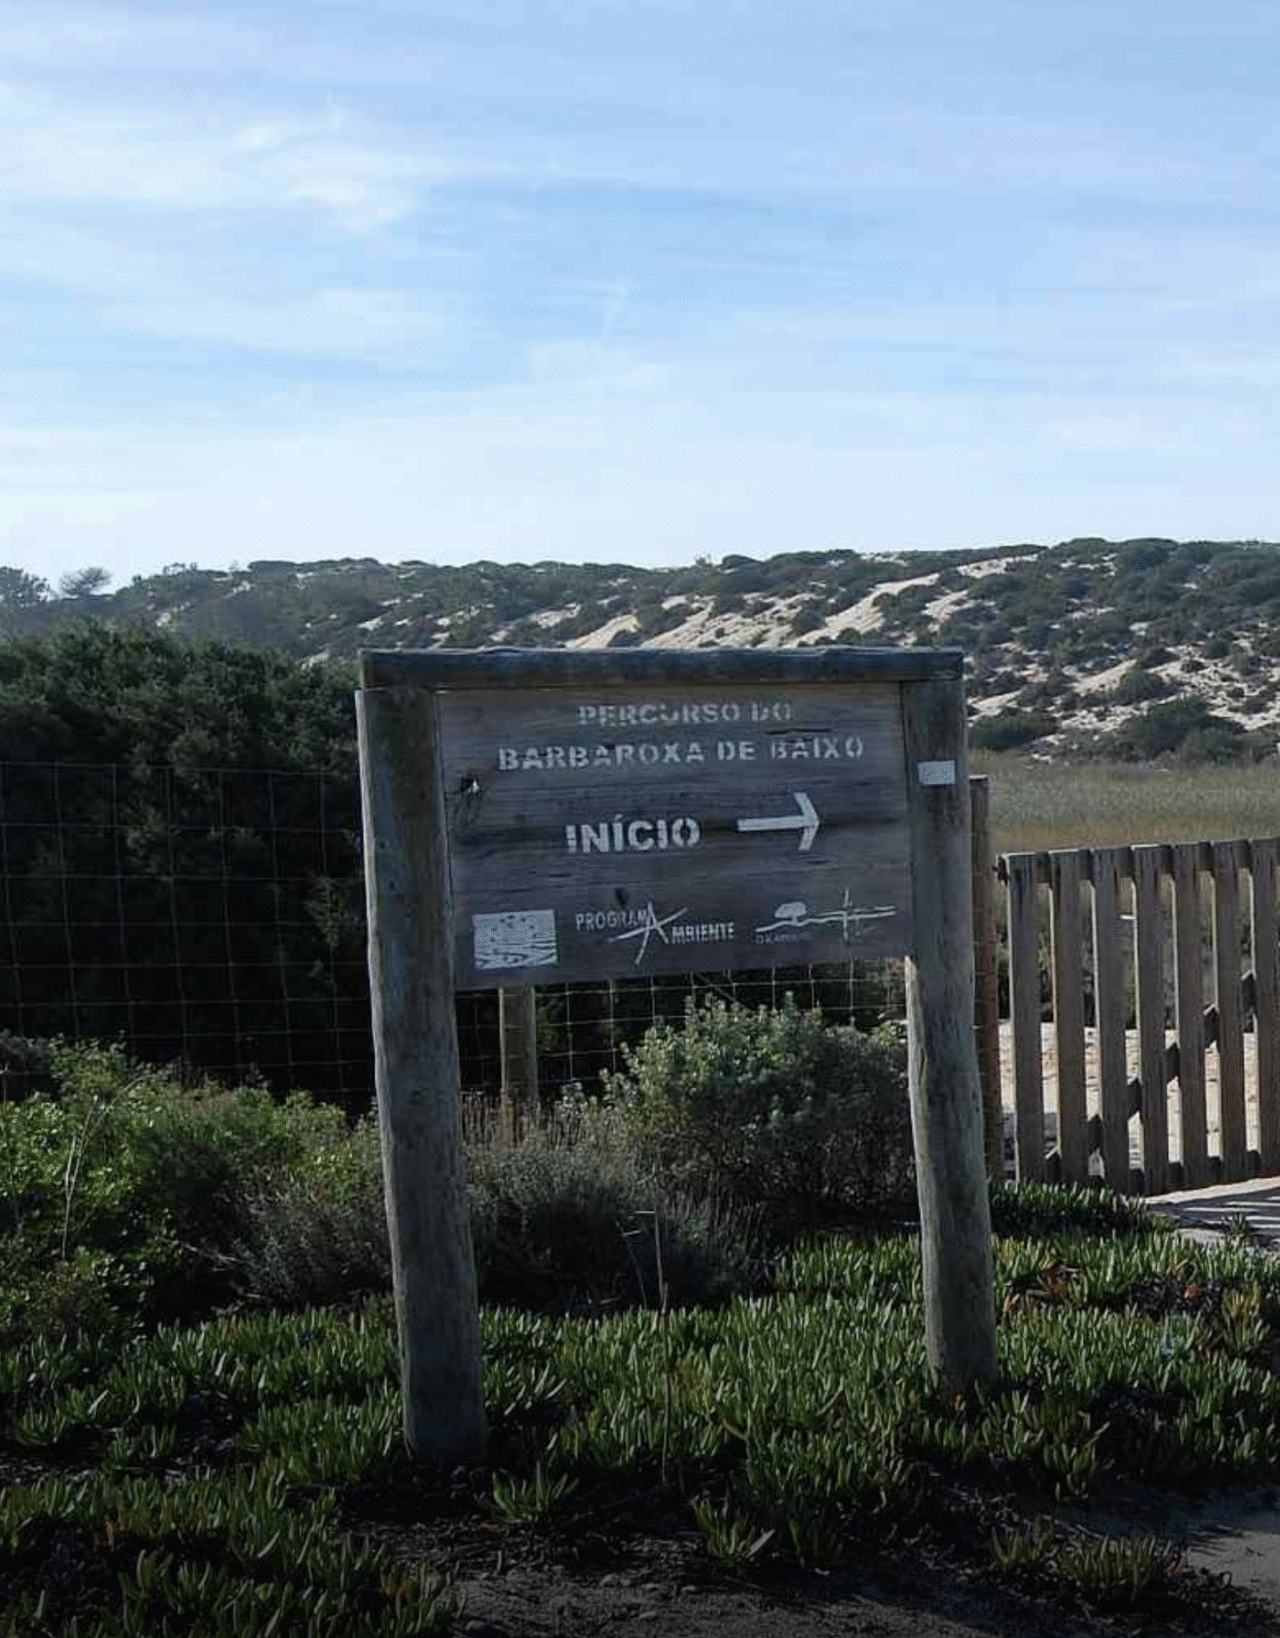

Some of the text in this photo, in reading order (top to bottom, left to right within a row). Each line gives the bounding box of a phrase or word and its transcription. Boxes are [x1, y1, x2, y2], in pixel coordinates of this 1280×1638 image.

[578, 701, 791, 726] PERCURSO DO
[498, 736, 863, 770] BARBAROXA DE BAIXO
[565, 813, 700, 854] INÍCIO
